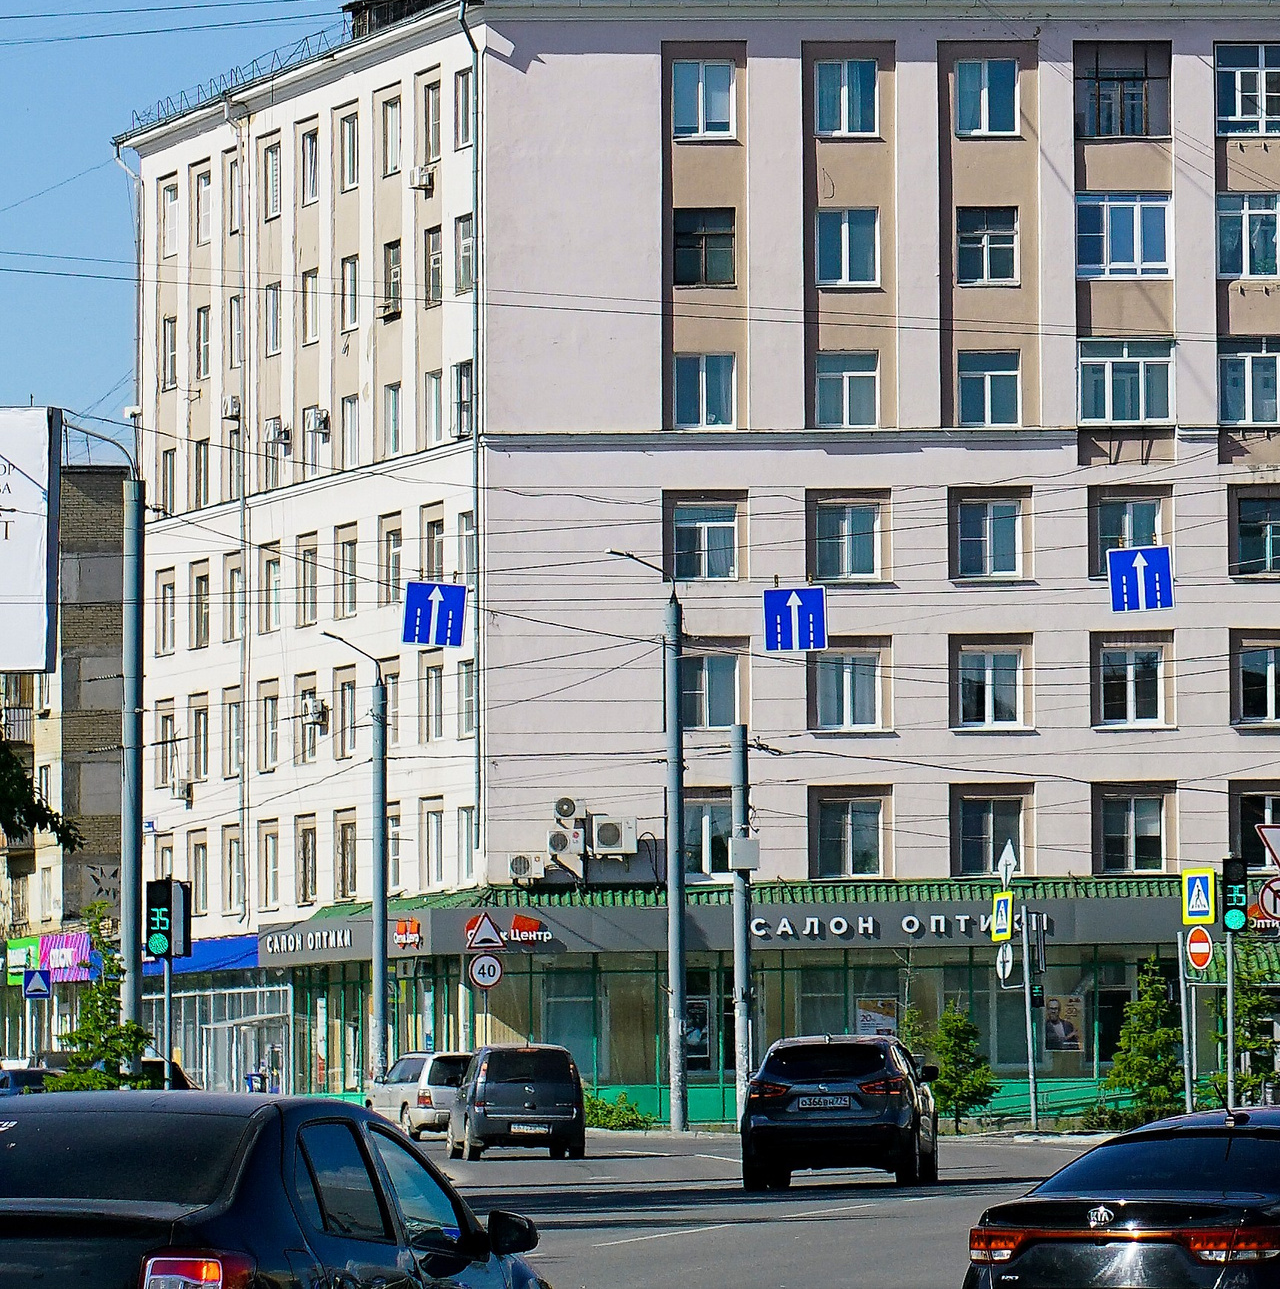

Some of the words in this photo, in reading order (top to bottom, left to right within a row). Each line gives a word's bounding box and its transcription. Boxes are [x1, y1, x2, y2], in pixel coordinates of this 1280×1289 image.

[150, 907, 169, 930] 35
[750, 915, 874, 936] САЛОН
[266, 932, 303, 953] САЛОН
[307, 928, 351, 950] ОПТИКИ
[510, 929, 553, 943] Центр
[478, 964, 496, 978] 40
